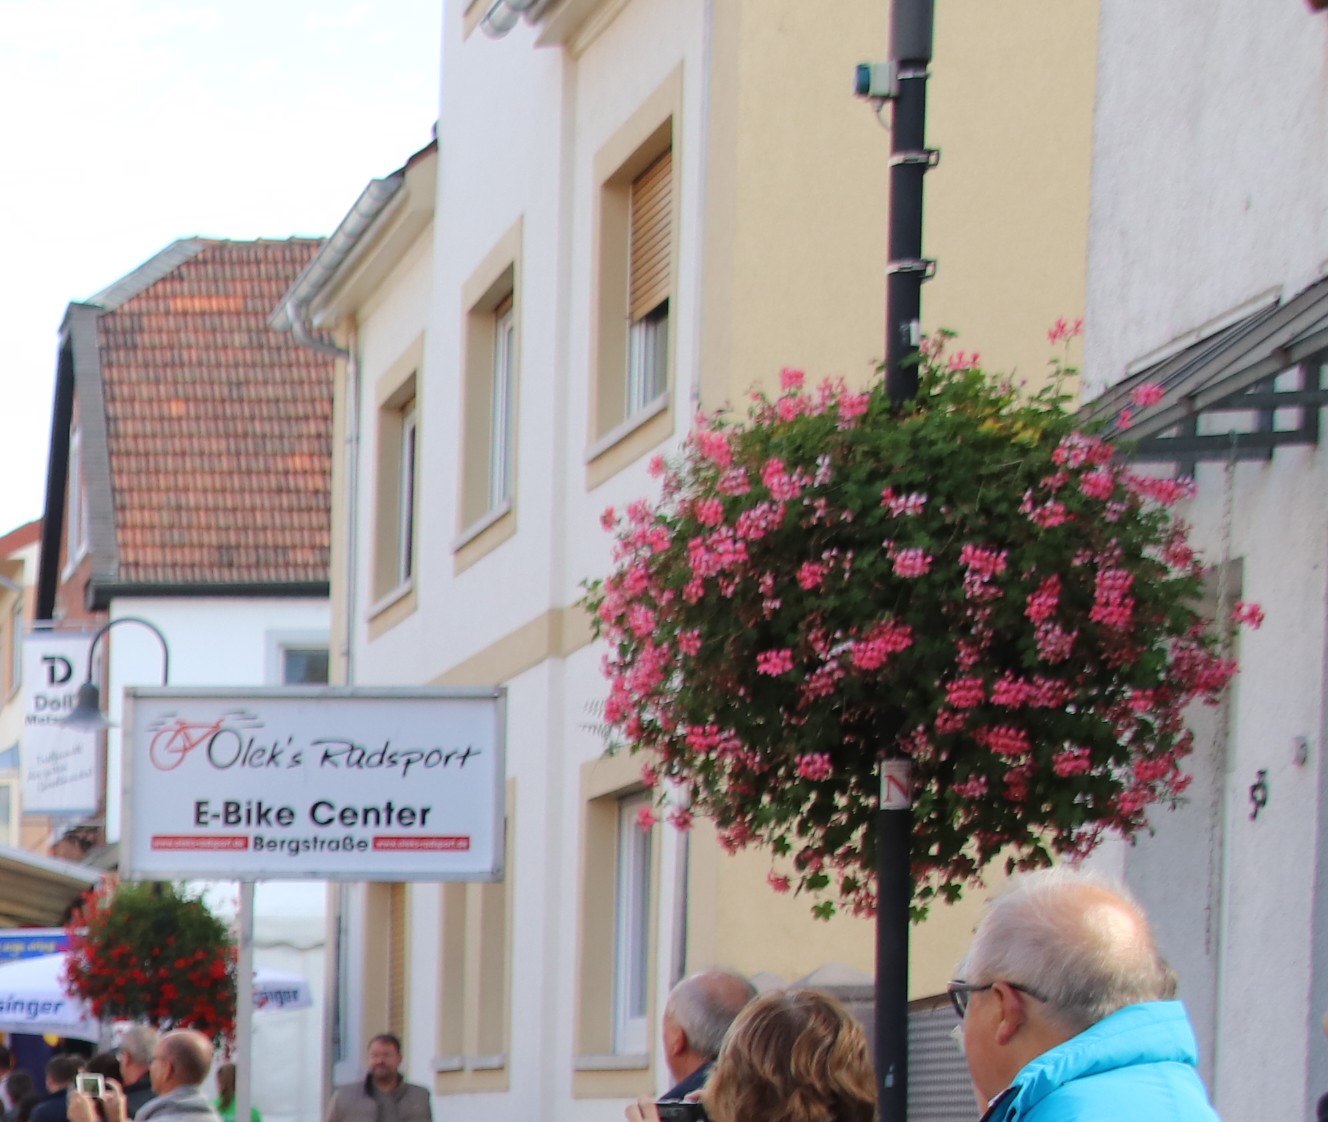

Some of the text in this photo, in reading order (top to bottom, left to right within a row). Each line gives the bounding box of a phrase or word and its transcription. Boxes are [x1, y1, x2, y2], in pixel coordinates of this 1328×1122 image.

[207, 728, 481, 778] Olek's Radsport
[194, 800, 431, 828] E-Bike Center
[252, 836, 369, 856] Bergstraße
